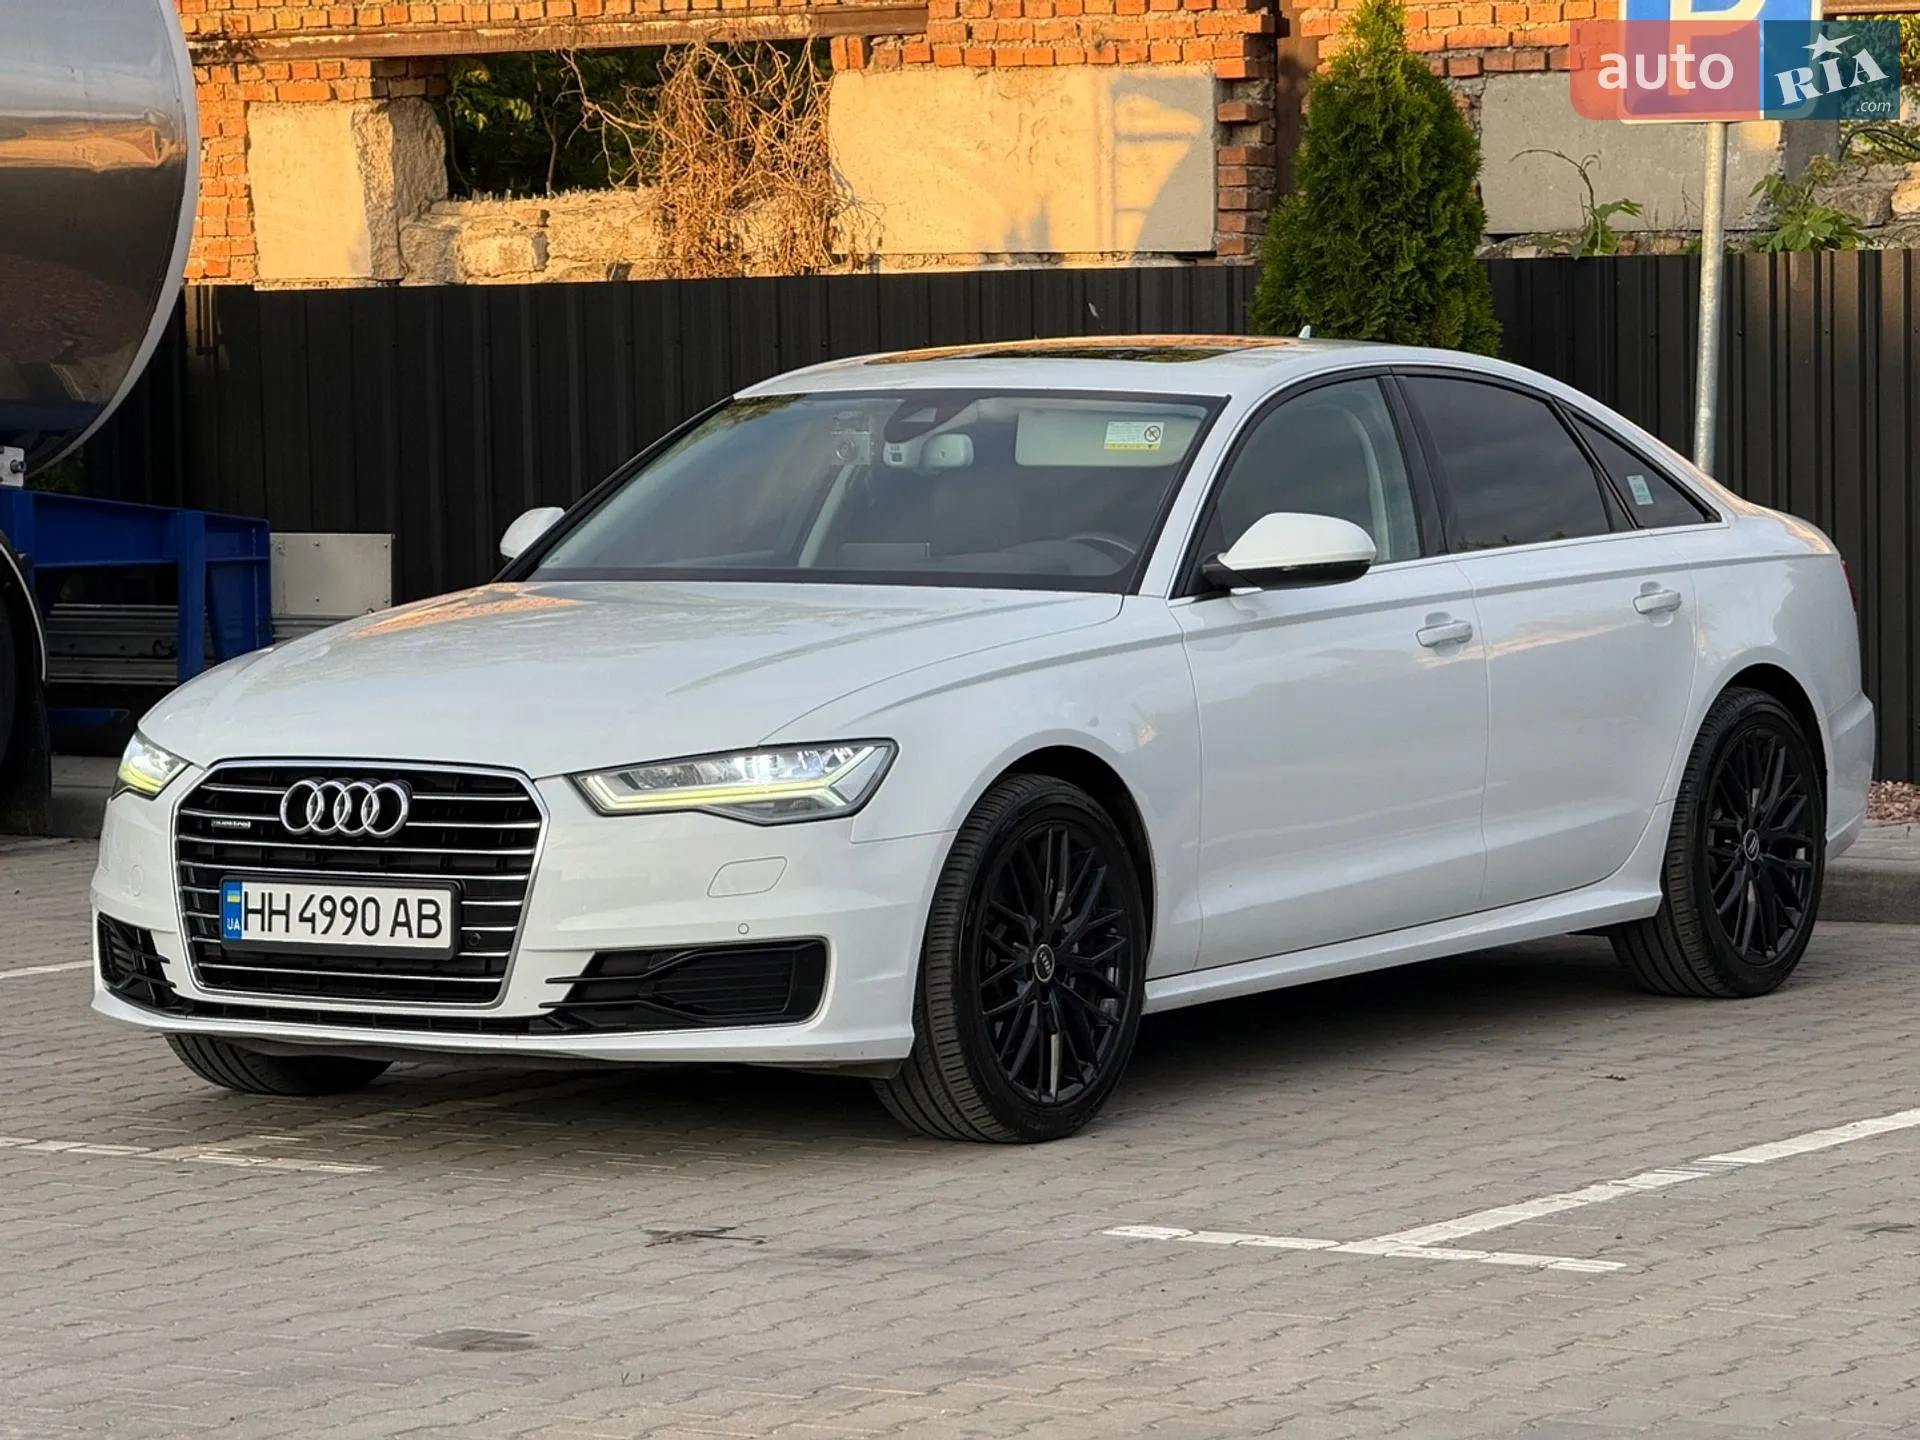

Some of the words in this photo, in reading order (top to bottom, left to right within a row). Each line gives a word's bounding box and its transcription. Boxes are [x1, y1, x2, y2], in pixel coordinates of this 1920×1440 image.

[226, 917, 241, 931] UA
[243, 891, 291, 933] HH
[299, 893, 381, 937] 4990
[389, 897, 443, 939] AB
